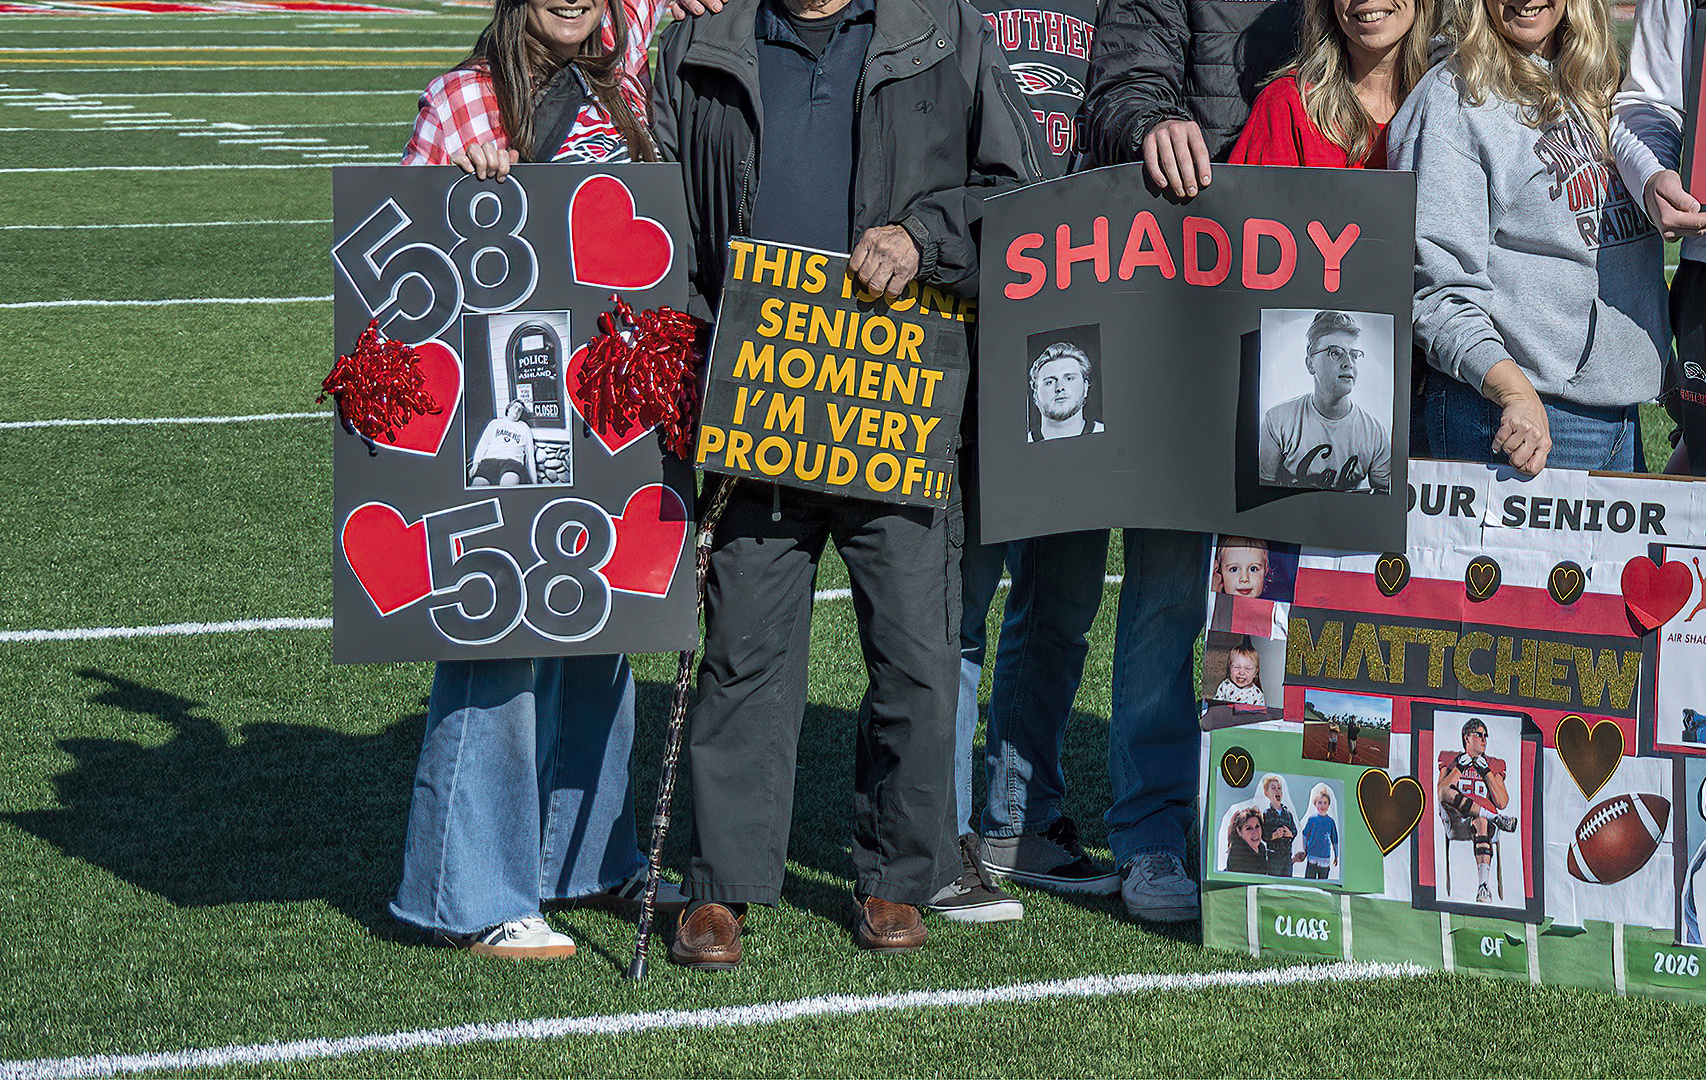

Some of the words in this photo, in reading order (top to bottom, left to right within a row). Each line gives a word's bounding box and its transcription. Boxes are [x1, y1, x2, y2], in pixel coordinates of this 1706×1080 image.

[983, 9, 1098, 62] UTHE
[331, 172, 540, 346] 58
[730, 240, 829, 294] THIS
[1004, 210, 1361, 300] SHADDY
[756, 297, 925, 363] SENIOR
[518, 354, 549, 368] POLICE
[518, 369, 552, 379] ASHLAND
[732, 340, 944, 408] MOMENT
[534, 403, 559, 417] CLOSED
[732, 386, 805, 434] I'M
[826, 402, 942, 454] VERY
[696, 425, 858, 486] PROUD
[1501, 495, 1668, 536] SENIOR
[422, 497, 618, 645] 58
[1286, 617, 1644, 710] MATTCHEW
[1667, 632, 1683, 643] AIR
[1653, 951, 1700, 977] 2026
